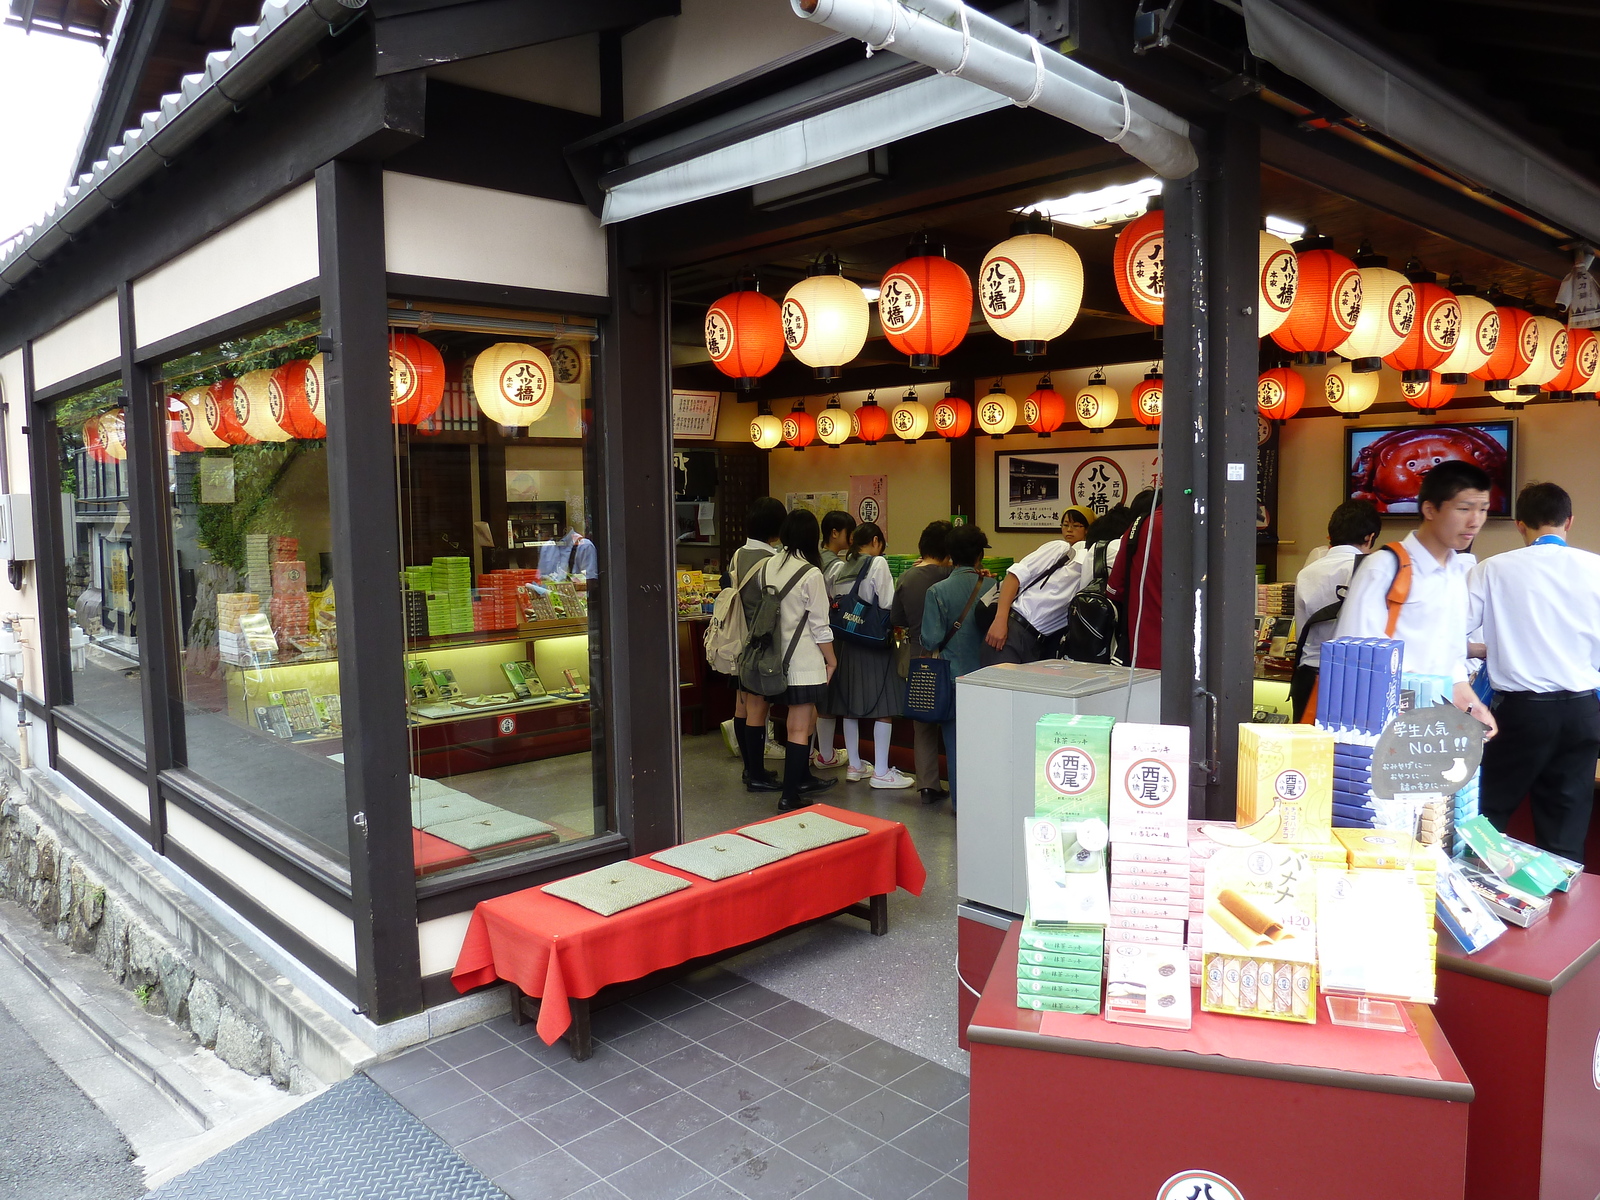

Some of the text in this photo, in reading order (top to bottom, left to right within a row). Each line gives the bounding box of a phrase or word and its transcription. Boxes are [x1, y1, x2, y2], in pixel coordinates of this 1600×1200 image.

[1135, 260, 1145, 278] 本家
[1269, 270, 1278, 288] 本家
[1077, 481, 1086, 498] 本家
[1111, 480, 1121, 498] 西尾
[864, 501, 873, 521] 西尾
[1393, 720, 1449, 738] 学生人気
[1060, 755, 1080, 788] 西尾
[1139, 766, 1161, 801] 西尾
[1284, 774, 1297, 796] 西尾
